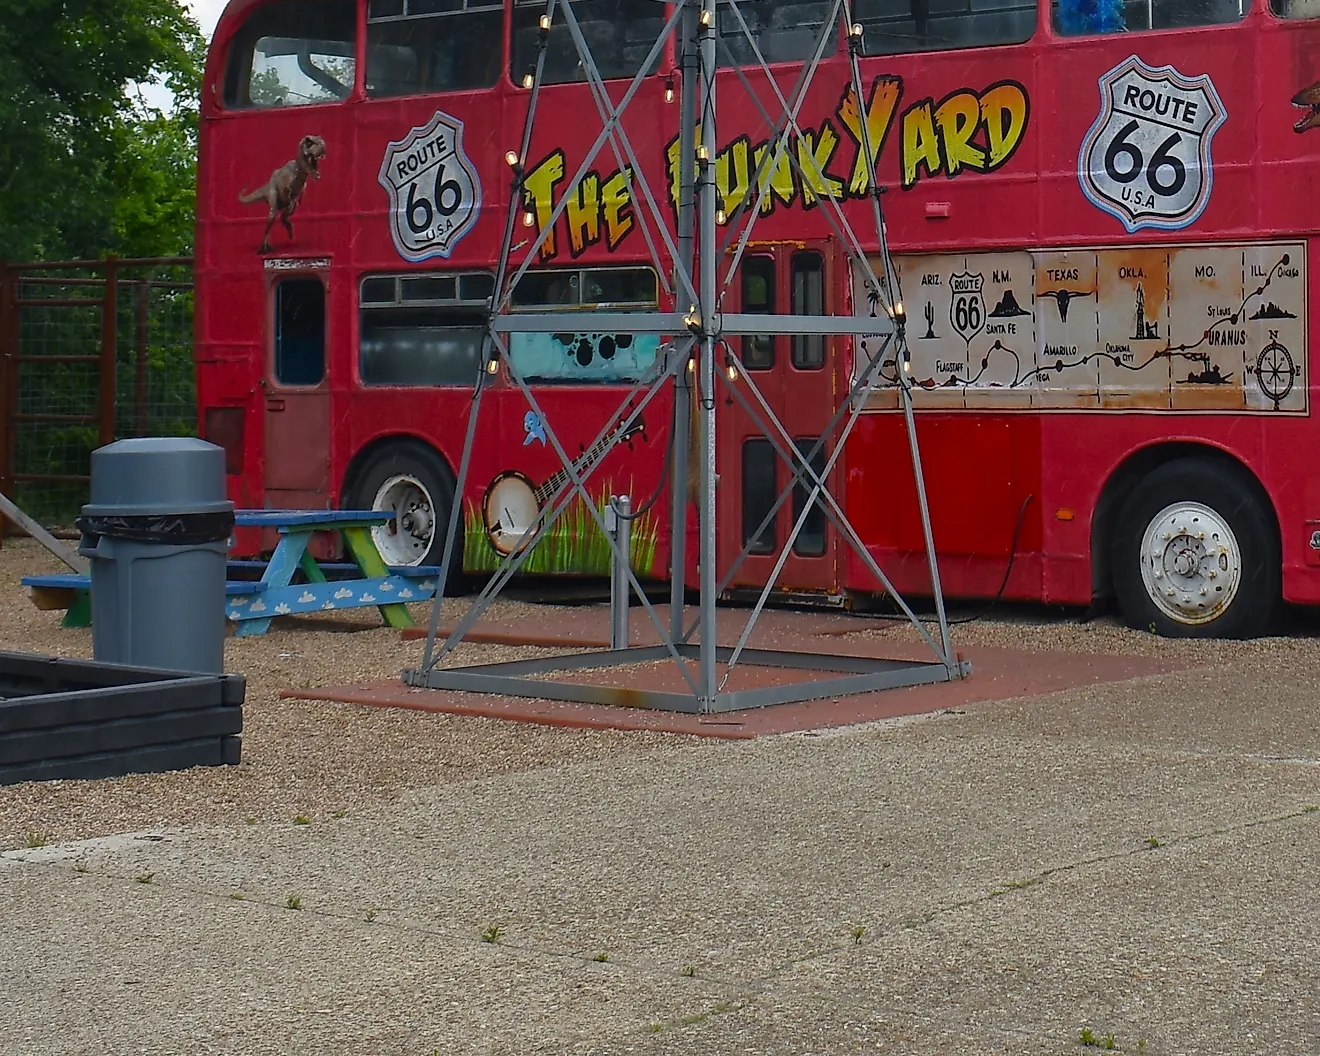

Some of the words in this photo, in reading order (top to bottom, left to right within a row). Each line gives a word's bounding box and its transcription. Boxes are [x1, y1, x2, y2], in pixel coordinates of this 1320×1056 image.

[1123, 84, 1198, 125] ROUTE
[396, 134, 448, 180] ROUTE
[1104, 119, 1186, 197] 66
[406, 163, 462, 234] 66
[1046, 268, 1079, 281] TEXAS
[1119, 267, 1147, 279] OKLA.
[1195, 265, 1216, 278] MO.
[921, 274, 943, 286] ARIZ.
[954, 278, 980, 291] ROUTE
[955, 296, 981, 332] 66
[1007, 323, 1017, 334] FE
[1268, 330, 1279, 340] N
[1208, 329, 1246, 346] URANUS
